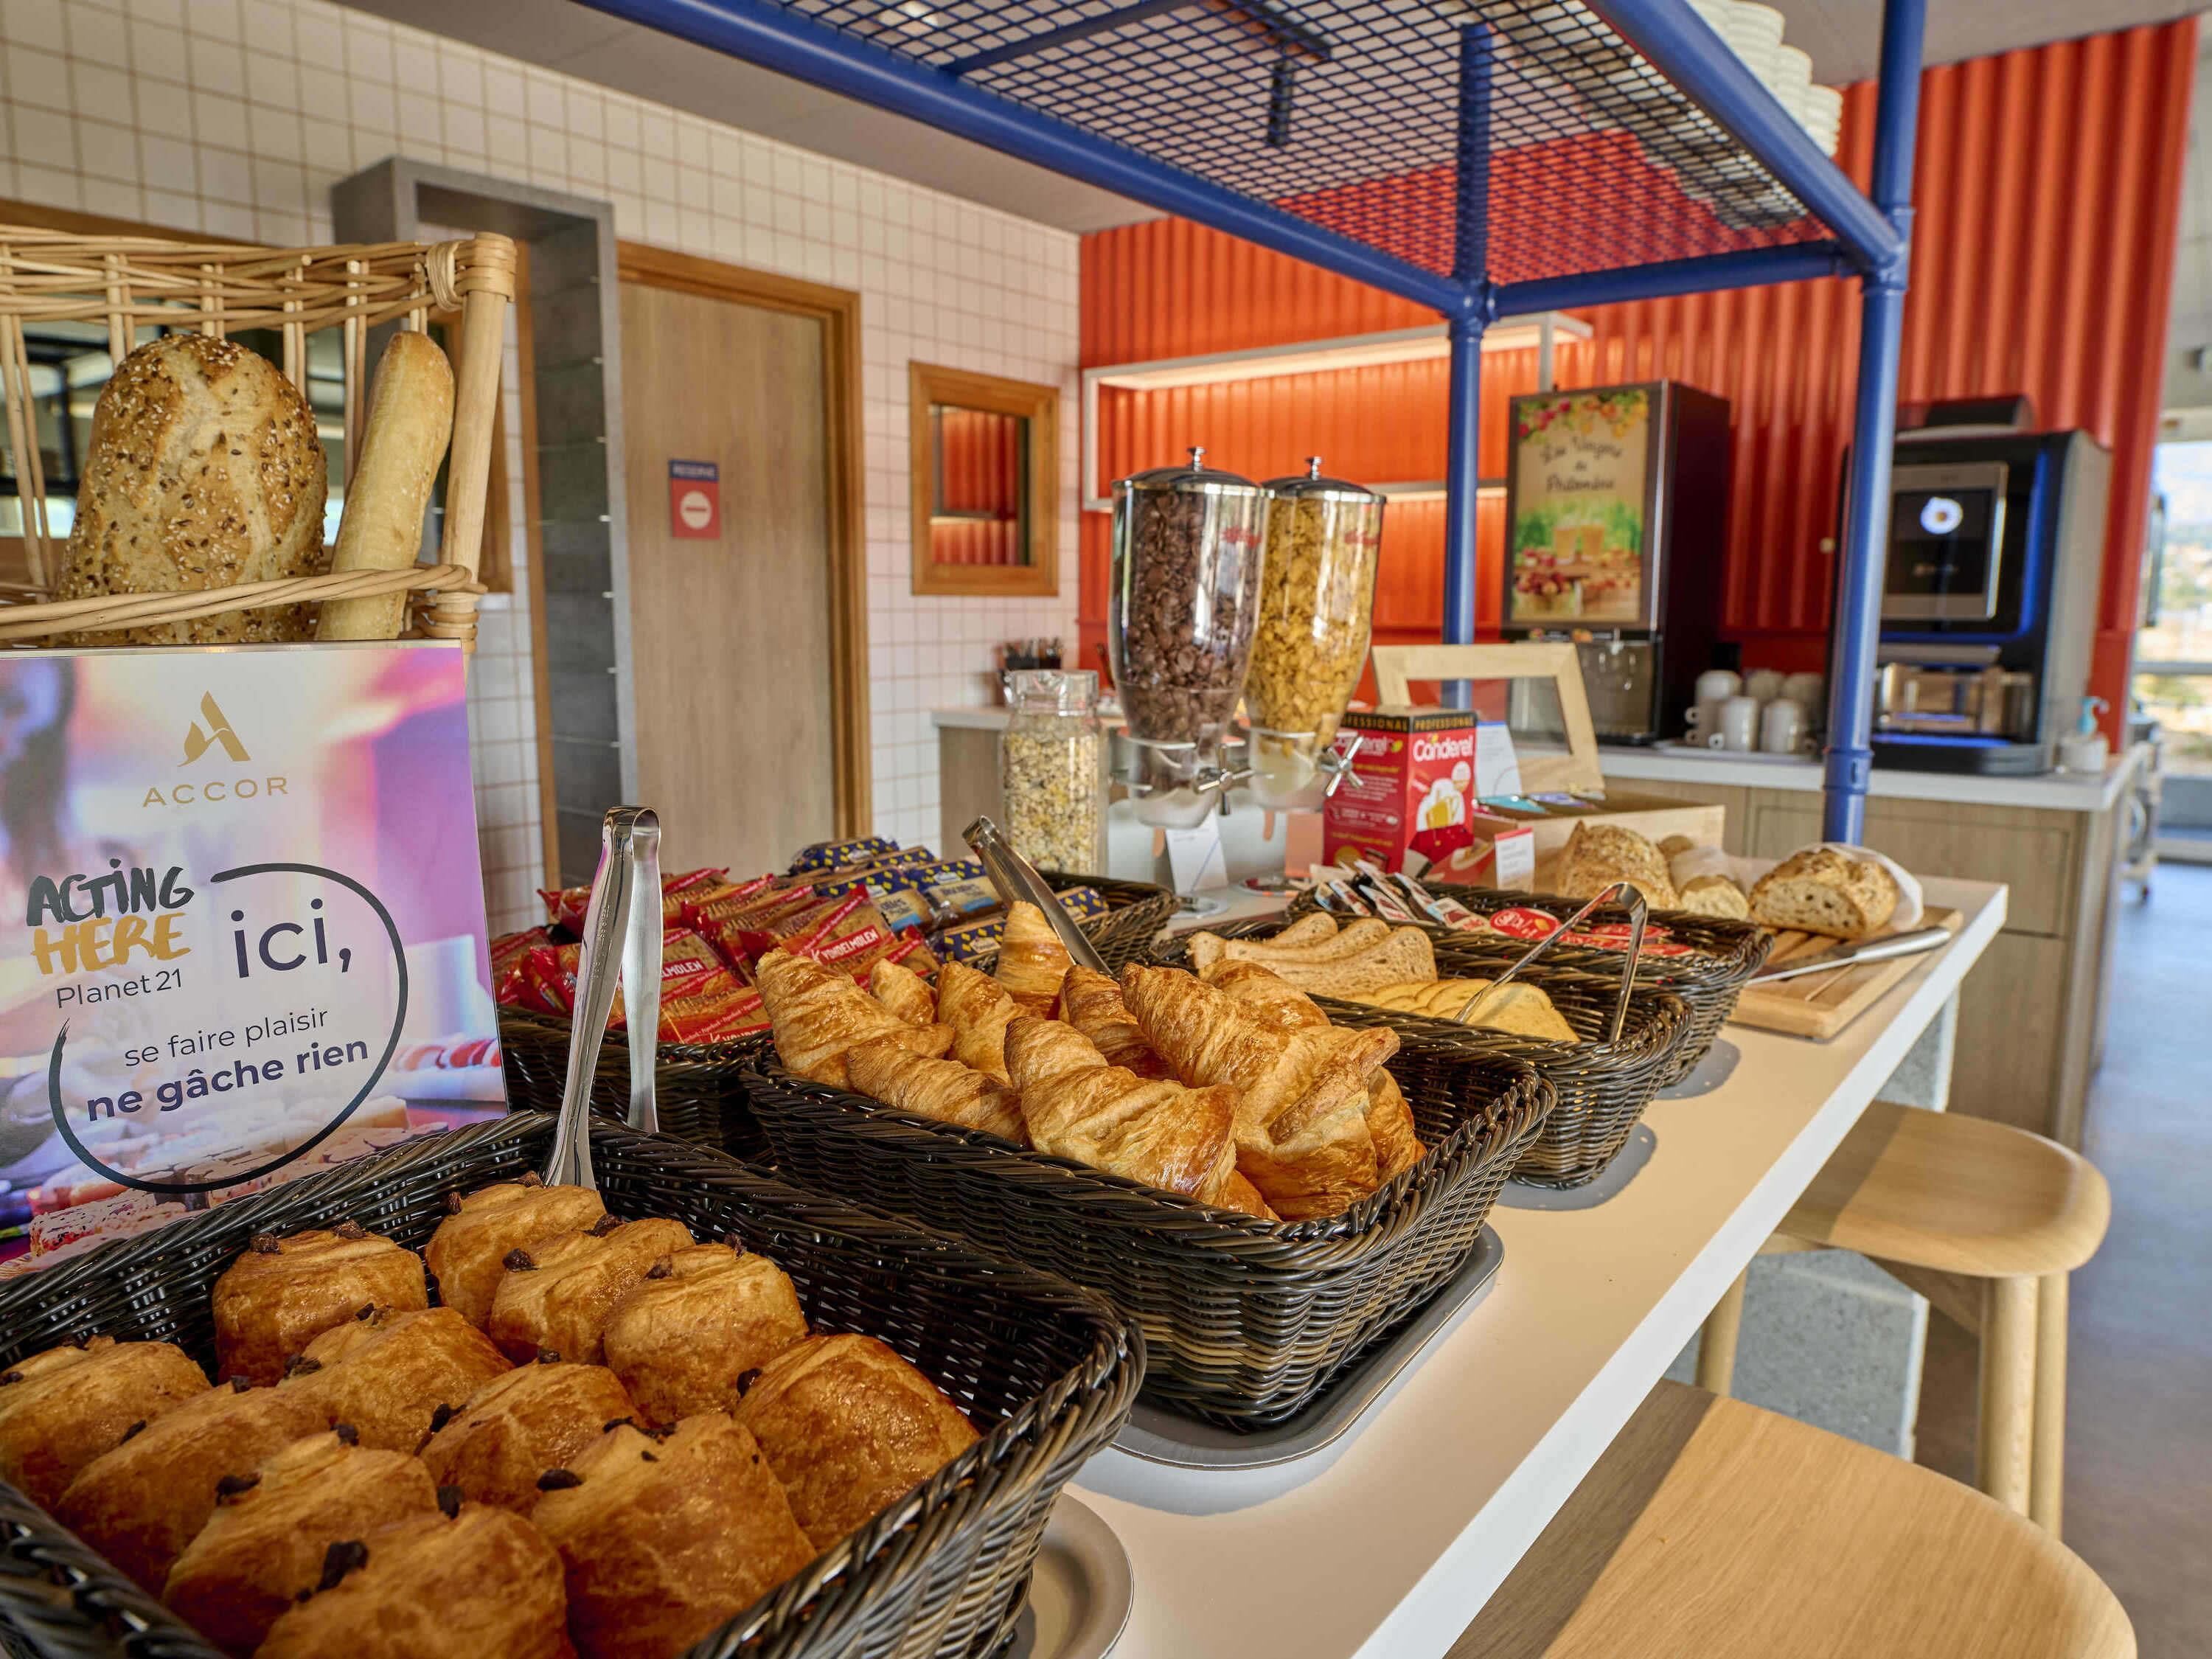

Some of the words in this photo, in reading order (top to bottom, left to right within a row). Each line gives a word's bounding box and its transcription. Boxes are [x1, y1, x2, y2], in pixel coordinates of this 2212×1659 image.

[142, 776, 288, 808] ACCOR
[27, 858, 195, 927] ACTING
[31, 912, 191, 975] HERE
[231, 898, 352, 978] ici,
[56, 974, 150, 1009] Planet
[156, 968, 182, 992] 21
[125, 1045, 159, 1067] se
[167, 1029, 235, 1058] faire
[245, 1007, 329, 1048] plaisir
[87, 1090, 143, 1121] ne
[156, 1060, 284, 1113] gâche
[297, 1040, 368, 1074] rien
